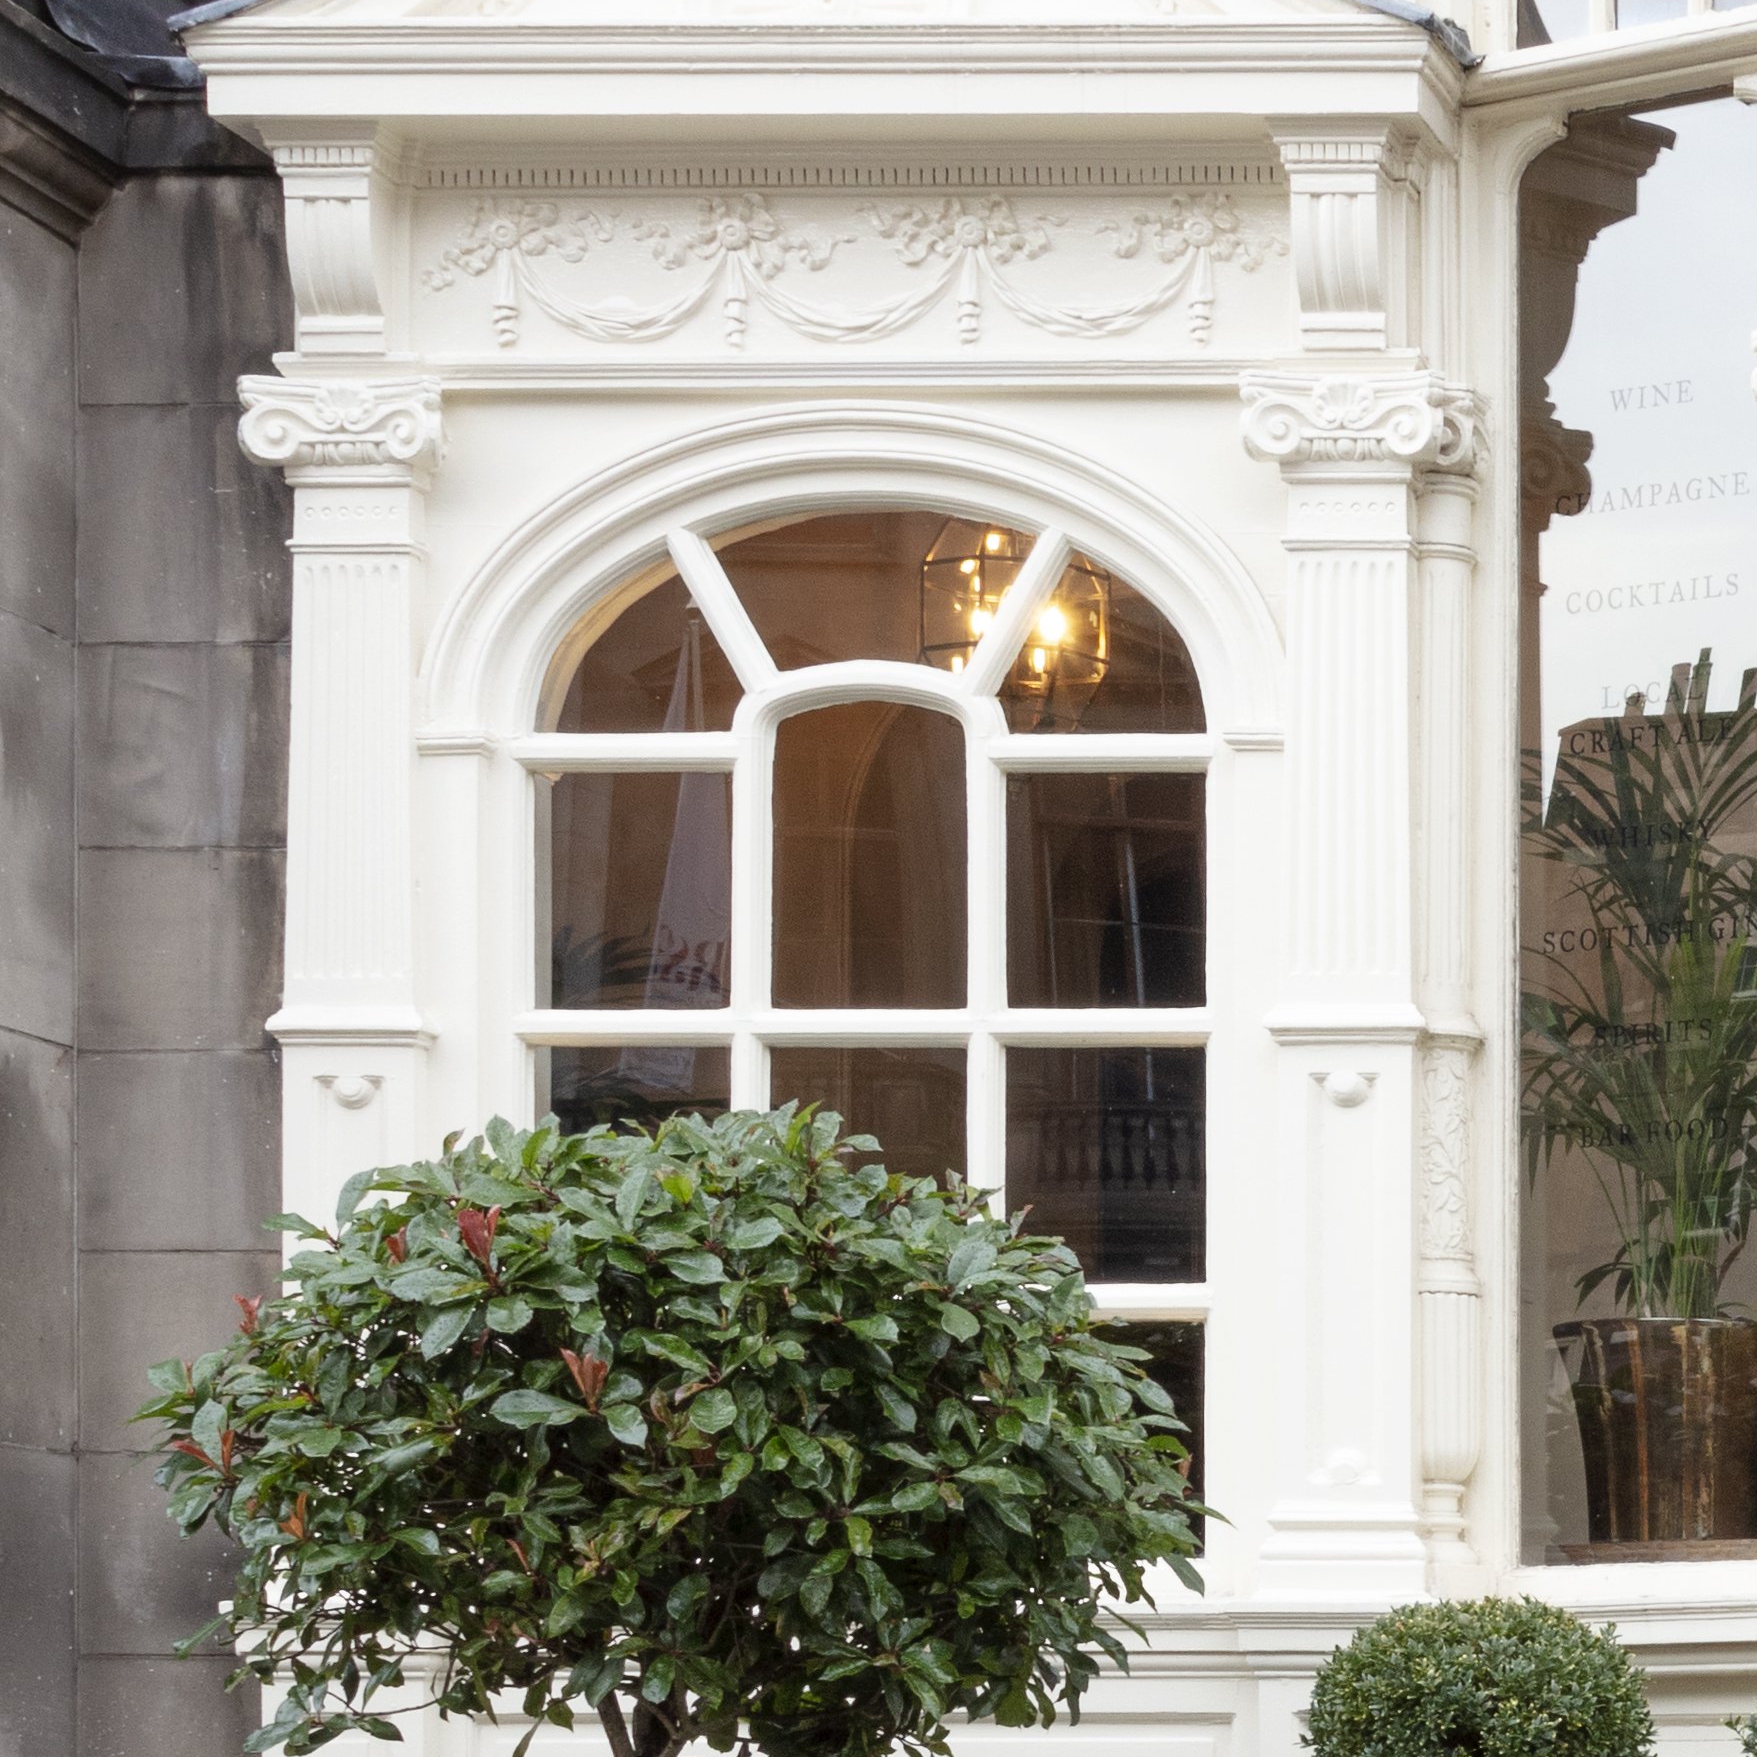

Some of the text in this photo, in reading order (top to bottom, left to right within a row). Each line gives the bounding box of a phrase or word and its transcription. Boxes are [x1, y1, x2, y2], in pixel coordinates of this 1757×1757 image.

[1610, 380, 1693, 412] WINE
[1555, 473, 1750, 516] CHAMPAGNE
[1567, 573, 1739, 614] COCKTAILS
[1602, 680, 1704, 710] LOCAL
[1570, 719, 1736, 756] CRAFT ALE
[1592, 821, 1712, 850] WHISKY
[1543, 922, 1695, 953] SCOTTISH
[1594, 1020, 1712, 1047] SPIRITS
[1581, 1118, 1728, 1147] BAR FOOD
